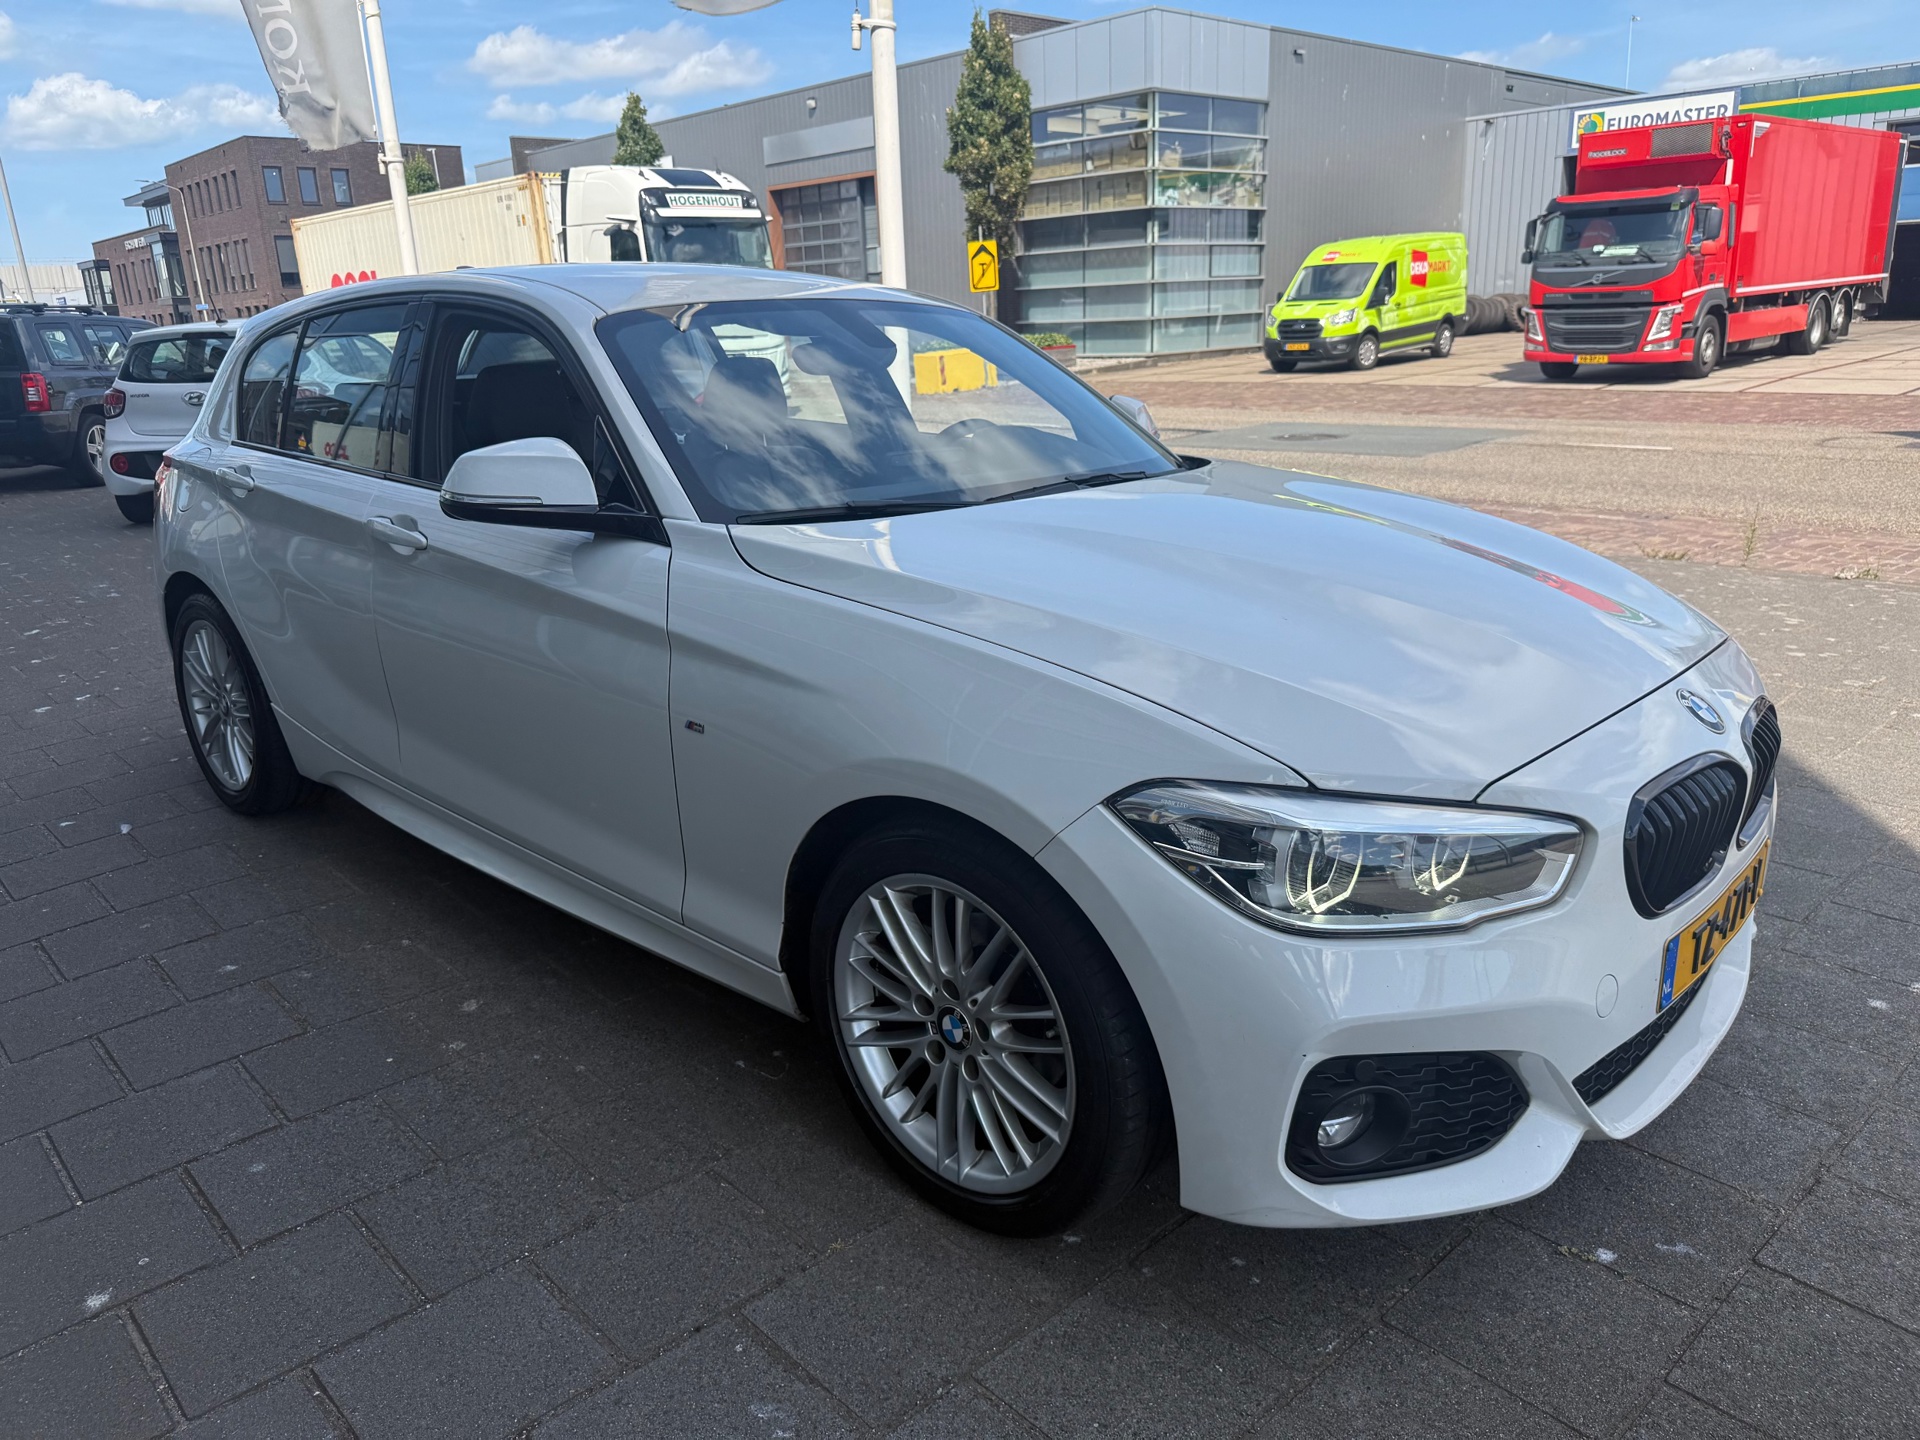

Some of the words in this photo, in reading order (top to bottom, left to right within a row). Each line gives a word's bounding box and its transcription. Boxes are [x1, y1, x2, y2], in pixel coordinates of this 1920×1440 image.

[1607, 104, 1728, 131] EUROMASTER
[669, 196, 740, 207] HOGENHOUT
[1661, 978, 1672, 998] NL
